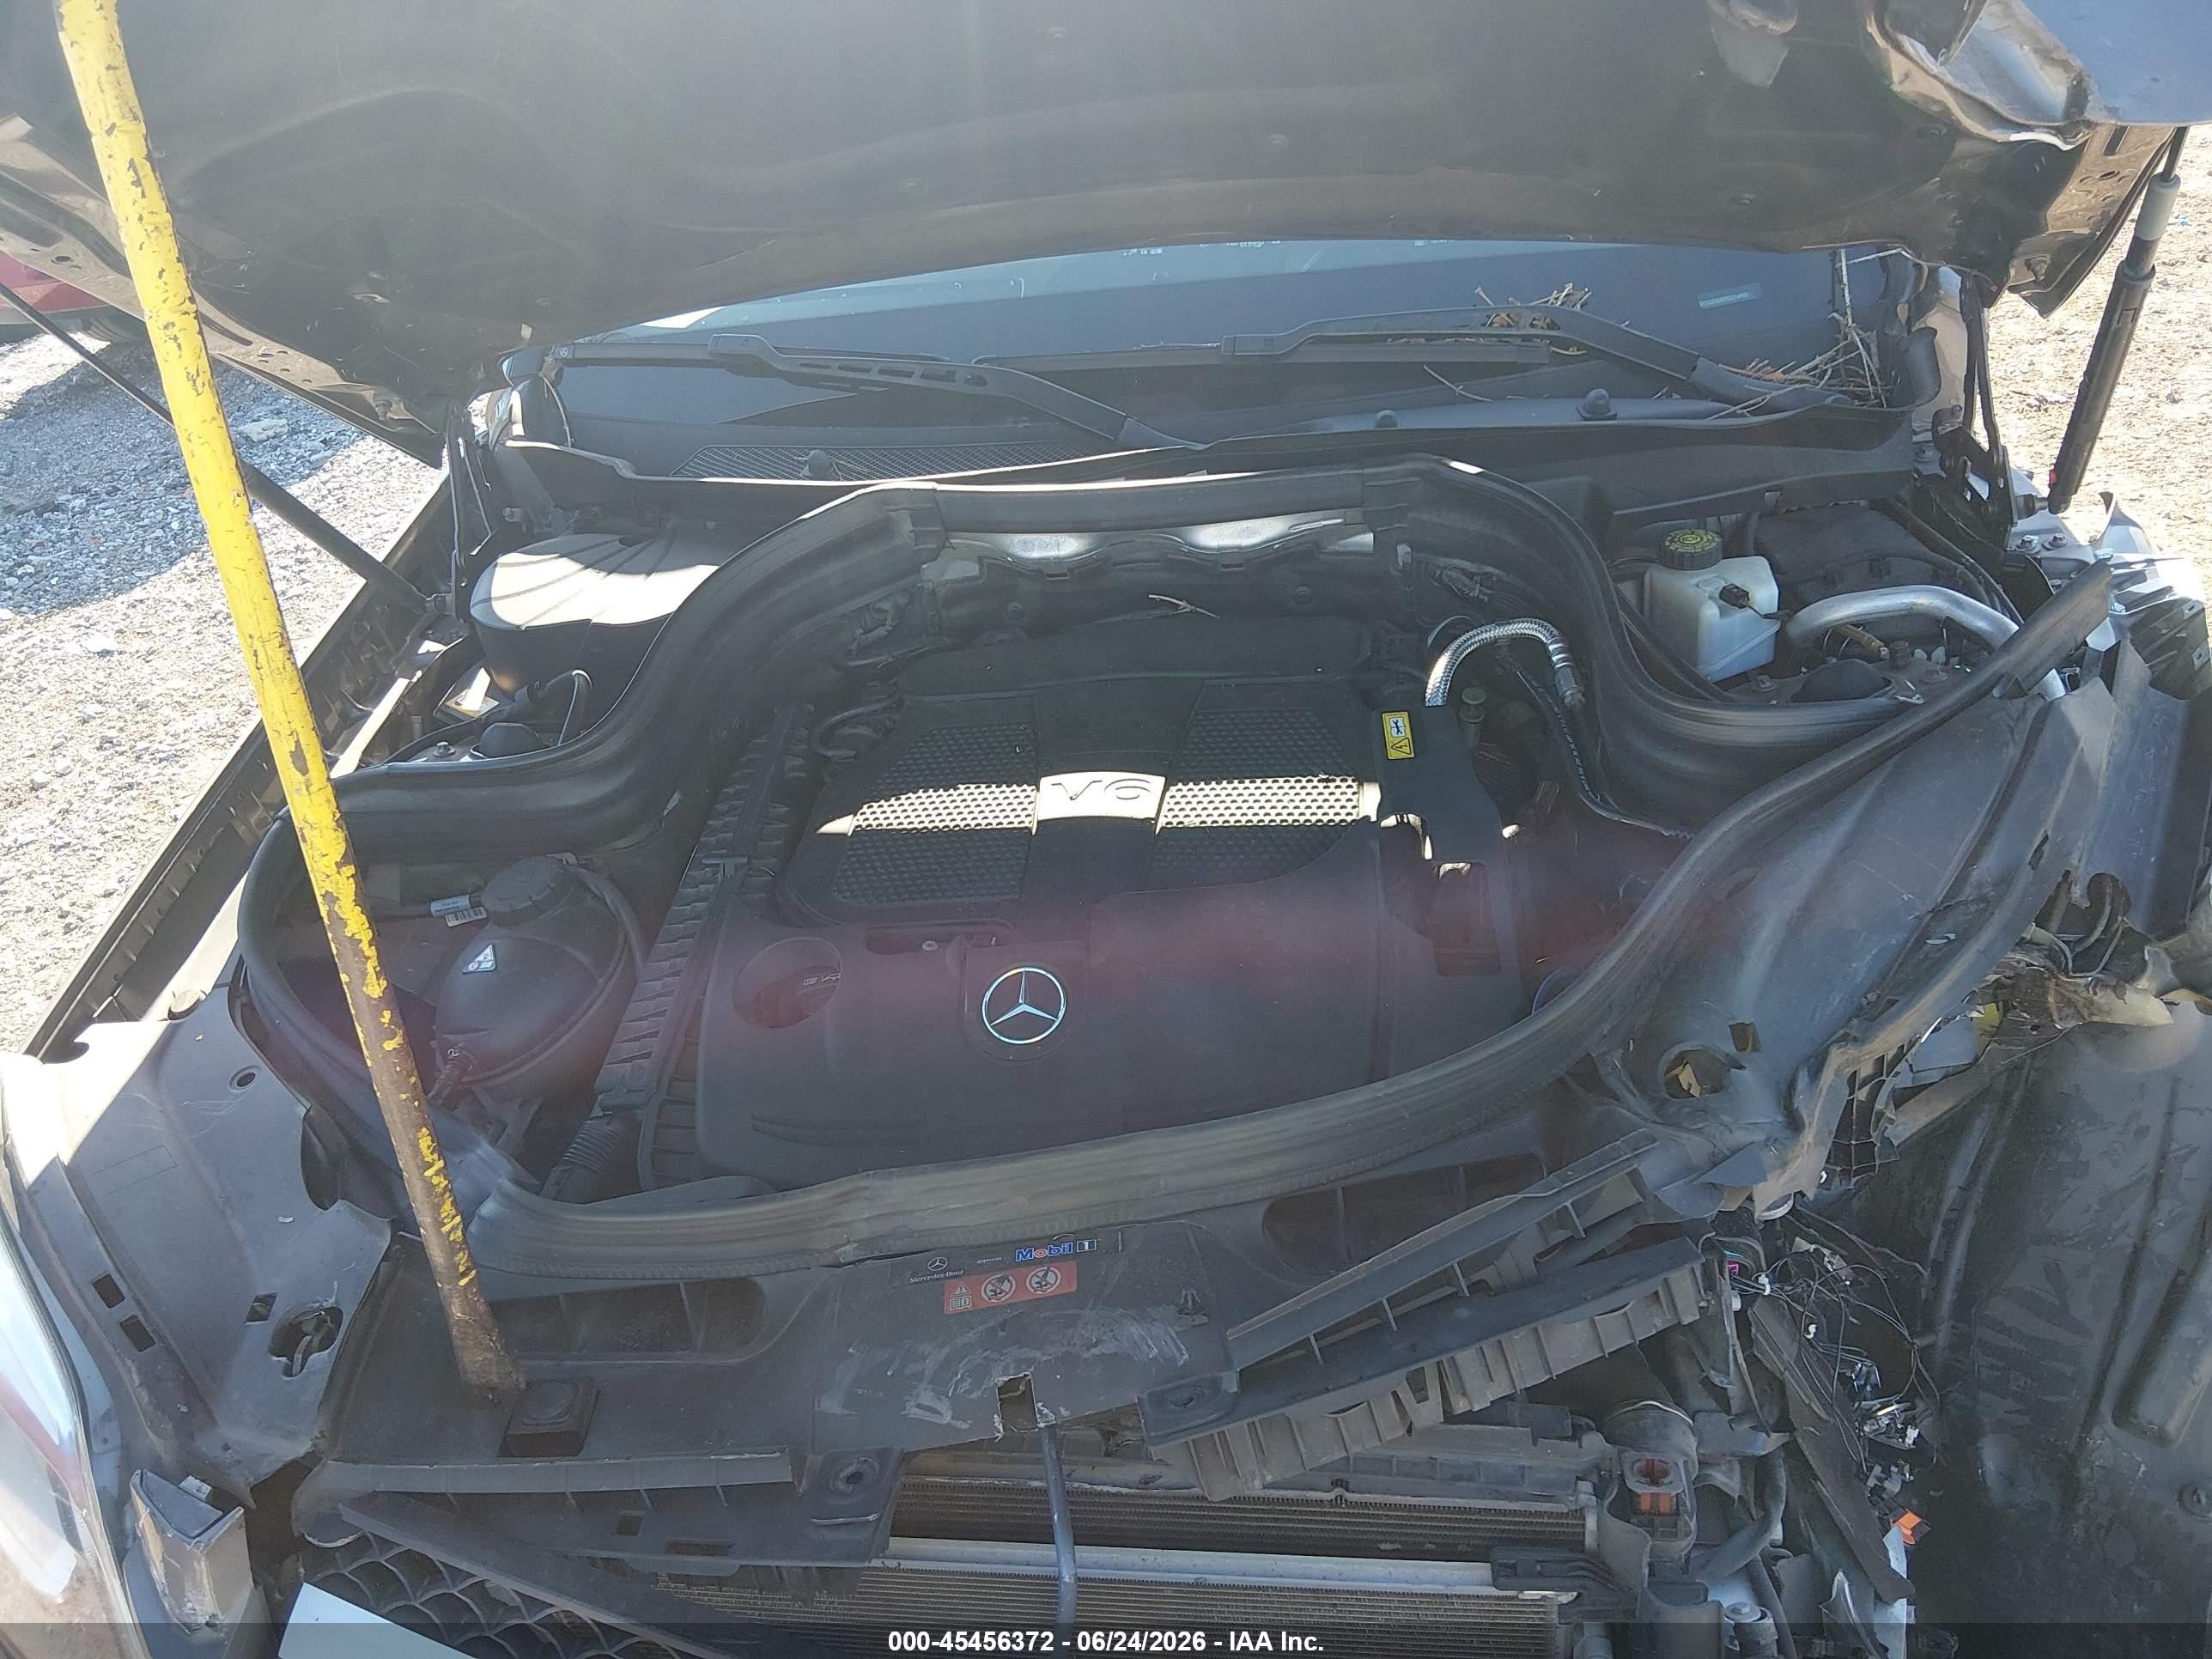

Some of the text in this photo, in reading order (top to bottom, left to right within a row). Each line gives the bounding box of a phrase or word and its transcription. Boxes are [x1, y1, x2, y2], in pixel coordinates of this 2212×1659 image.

[1050, 778, 1153, 803] V6
[1015, 1242, 1073, 1262] Mobil
[908, 1269, 964, 1284] Mercedes-Benz
